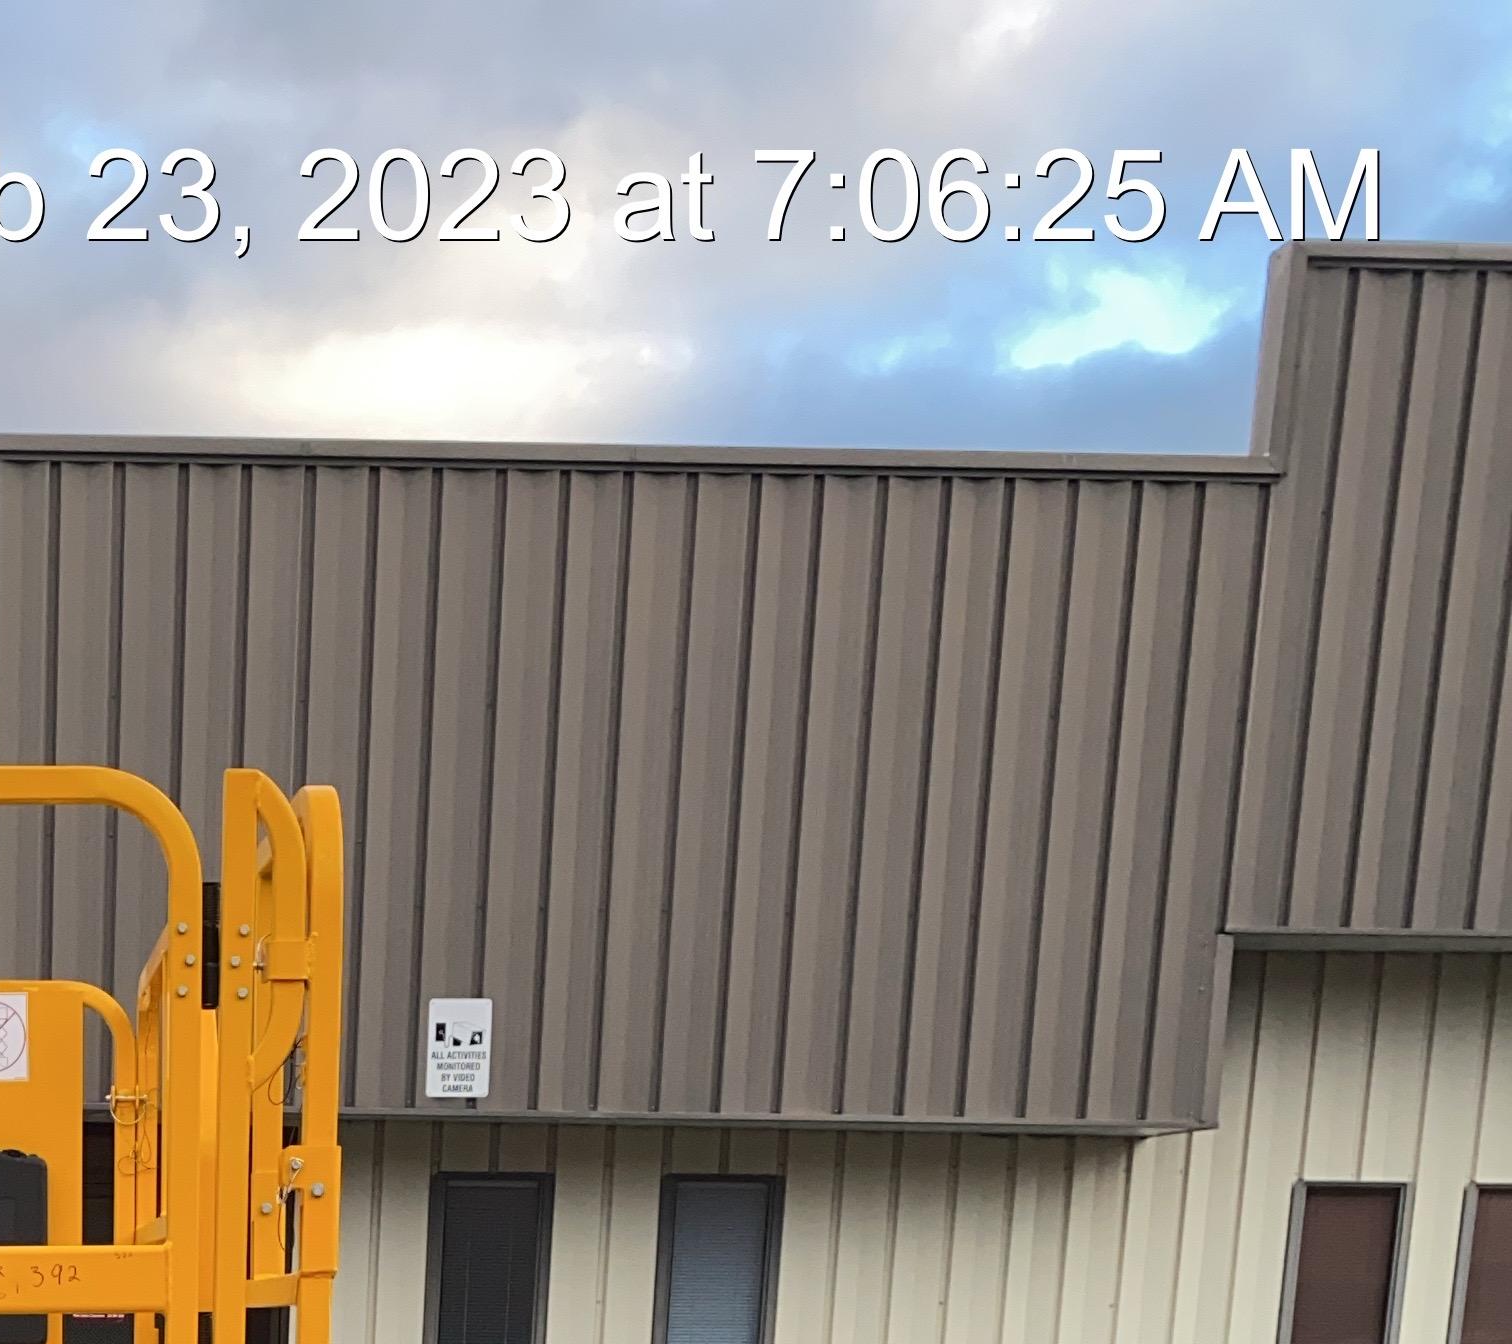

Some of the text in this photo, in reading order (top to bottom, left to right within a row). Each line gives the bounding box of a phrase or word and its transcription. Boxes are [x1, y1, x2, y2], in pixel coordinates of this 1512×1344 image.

[431, 1051, 487, 1060] ALL ACTIVITIES
[436, 1062, 481, 1071] MONITORED
[441, 1073, 476, 1082] BY VIDEO
[442, 1084, 474, 1093] CAMERA
